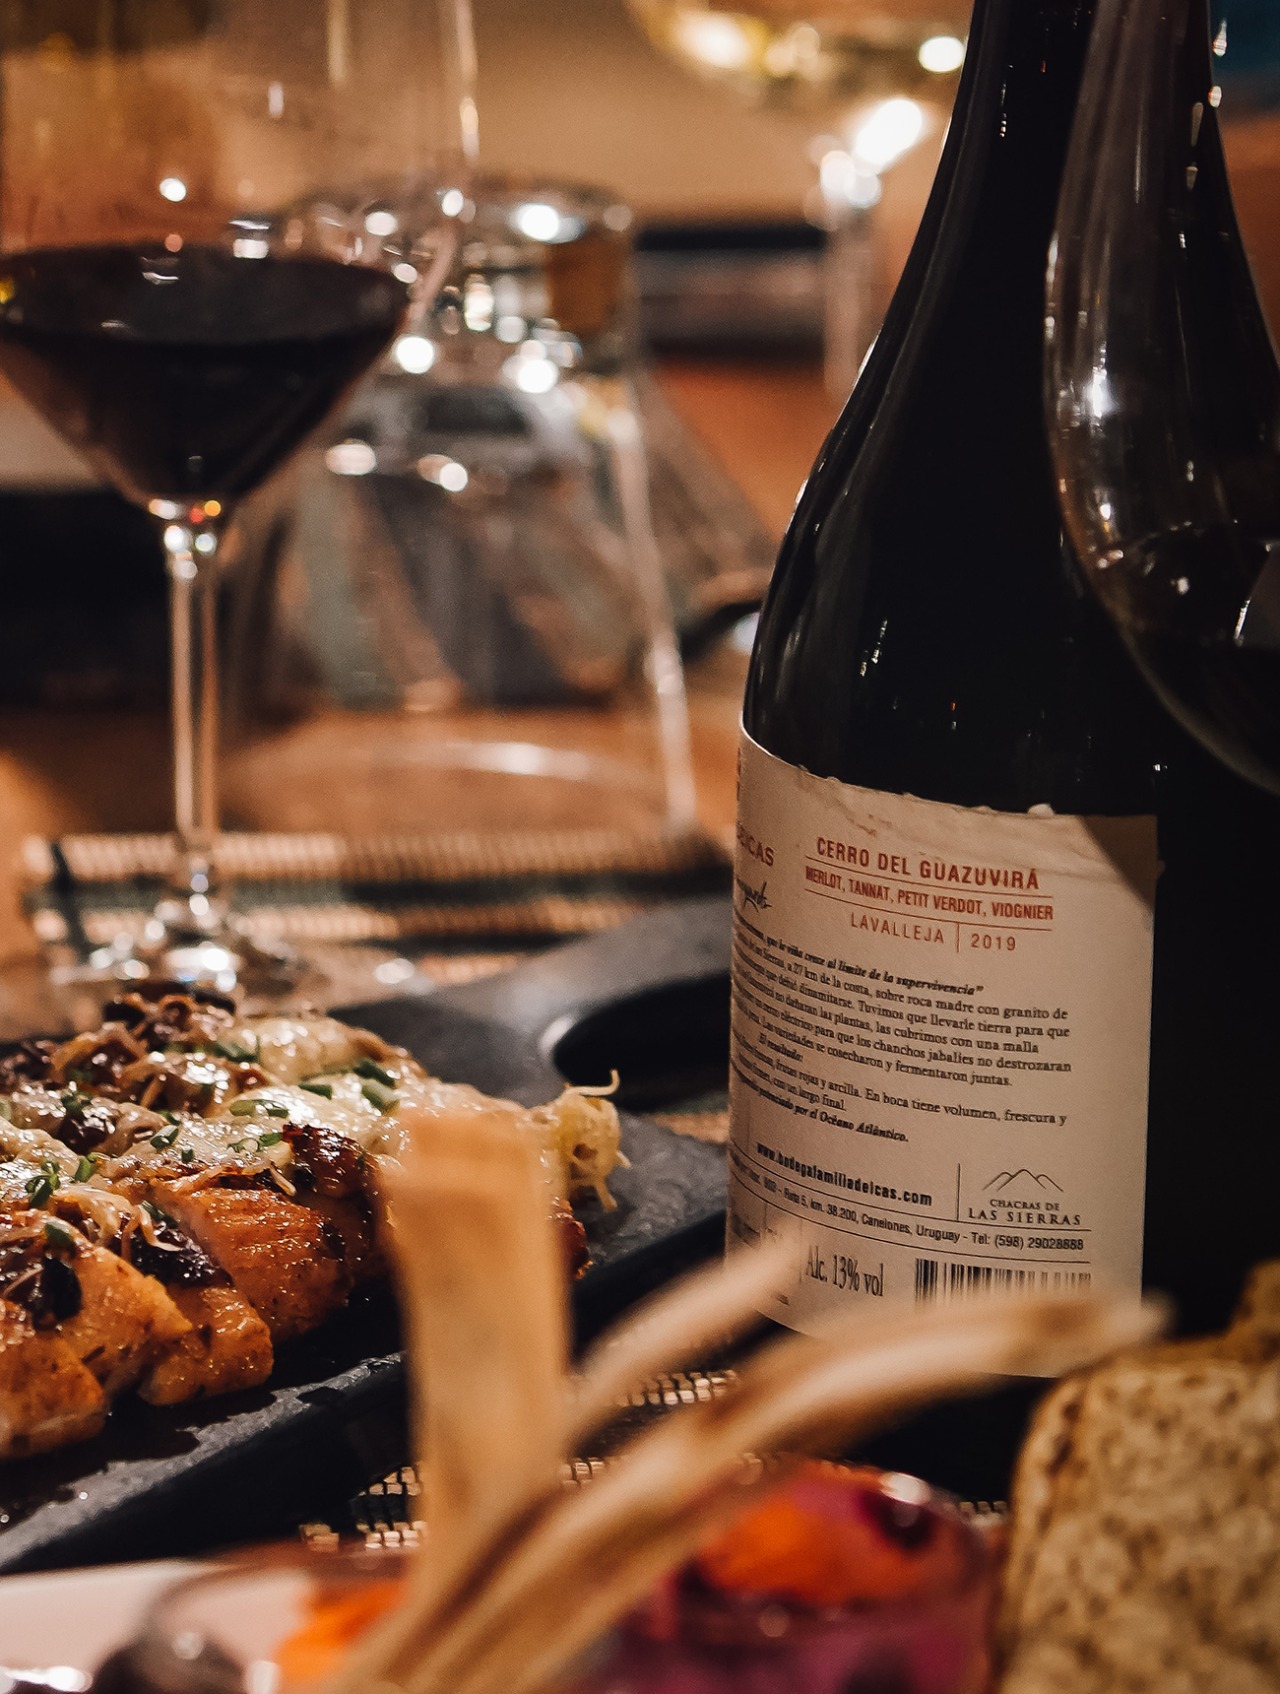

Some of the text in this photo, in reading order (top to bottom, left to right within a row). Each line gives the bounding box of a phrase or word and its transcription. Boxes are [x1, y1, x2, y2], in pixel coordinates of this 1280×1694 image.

[817, 836, 1040, 890] CERRO DEL GUAZUVIRÁ
[805, 865, 1054, 920] MERLOT, TANNAT, PETIT VERDOT, VIOGNIER
[851, 912, 1016, 951] LAVALLEJA 2019
[804, 966, 818, 982] km
[820, 972, 831, 985] de
[832, 974, 841, 988] la
[844, 981, 873, 998] costa,
[876, 988, 904, 1003] sobre
[907, 995, 932, 1008] roca
[936, 1000, 974, 1014] madre
[977, 1005, 1000, 1016] con
[1003, 1007, 1050, 1019] granito
[1052, 1008, 1068, 1020] de
[869, 968, 881, 980] de
[883, 970, 894, 983] la
[820, 1006, 832, 1021] las
[834, 1012, 873, 1033] plantas,
[876, 1021, 891, 1035] las
[894, 1027, 948, 1046] cubrimos
[950, 1037, 973, 1048] con
[977, 1040, 1000, 1051] una
[1003, 1041, 1039, 1054] malla
[858, 999, 904, 1020] Tuvimos
[906, 1013, 928, 1025] que
[931, 1014, 975, 1031] llevarle
[978, 1021, 1012, 1034] tierra
[1015, 1026, 1044, 1037] para
[1047, 1027, 1070, 1039] que
[815, 1025, 835, 1039] para
[837, 1031, 855, 1046] que
[857, 1034, 871, 1048] los
[873, 1039, 926, 1059] chanchos
[977, 1056, 993, 1067] no
[996, 1057, 1072, 1072] destrozaran
[816, 1042, 826, 1053] se
[827, 1046, 883, 1069] cosecharon
[886, 1062, 893, 1073] y
[895, 1060, 968, 1081] fermentaron
[970, 1071, 1013, 1086] juntas.
[821, 1079, 827, 1090] y
[828, 1081, 862, 1098] arcilla.
[865, 1088, 880, 1101] En
[883, 1092, 909, 1108] boca
[911, 1100, 941, 1113] tiene
[943, 1104, 1001, 1121] volumen,
[1004, 1109, 1056, 1124] frescura
[1059, 1115, 1067, 1127] y
[827, 1203, 859, 1224] 38.200,
[916, 1224, 961, 1244] Uruguay
[971, 1231, 991, 1245] Tel:
[995, 1235, 1024, 1250] (598)
[1028, 1237, 1084, 1250] 29028888
[968, 1207, 1081, 1226] LAS SIERRAS
[989, 1199, 1061, 1211] CHACRAS DE
[806, 1244, 884, 1297] Alc. 13% vol
